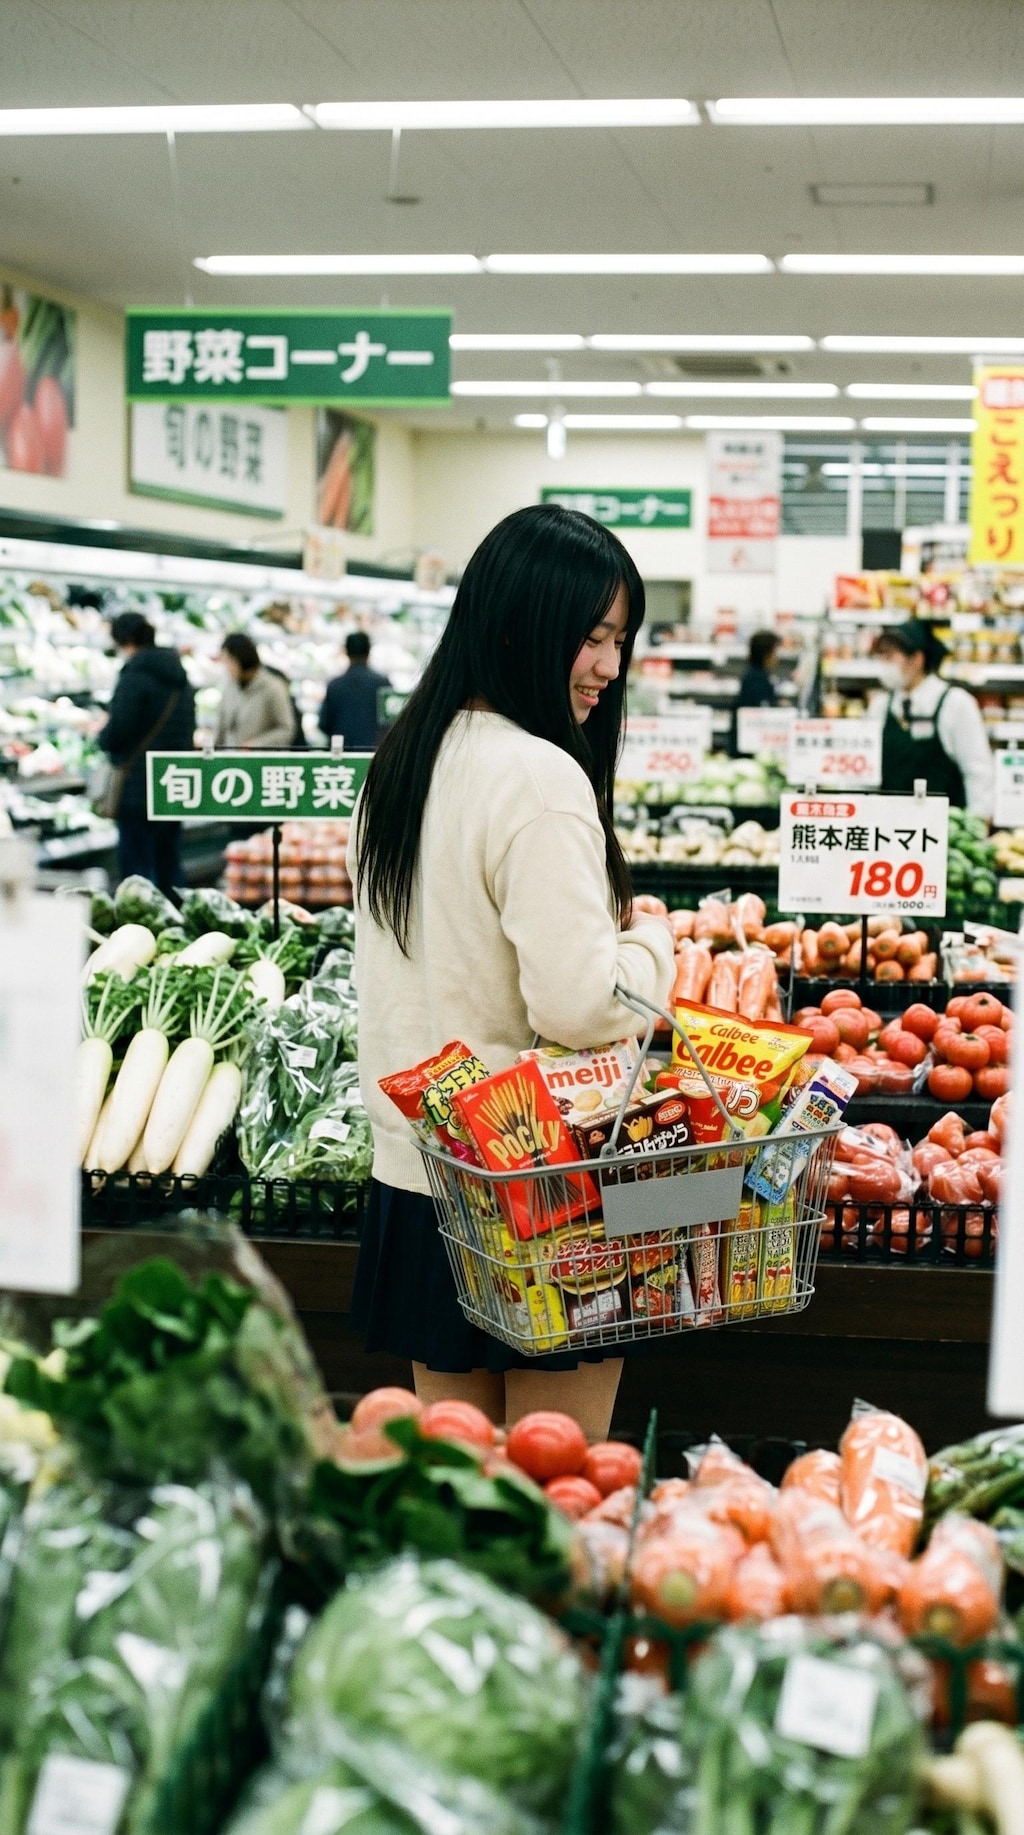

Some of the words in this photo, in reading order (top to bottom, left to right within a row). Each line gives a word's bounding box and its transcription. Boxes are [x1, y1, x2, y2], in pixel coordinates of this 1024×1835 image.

[143, 329, 435, 384] 野菜コーナー
[160, 764, 356, 810] 旬の野菜
[791, 824, 939, 852] 熊本産トマト
[710, 1024, 759, 1044] Calbee
[546, 1056, 622, 1089] meiji
[676, 1034, 773, 1080] Calbee
